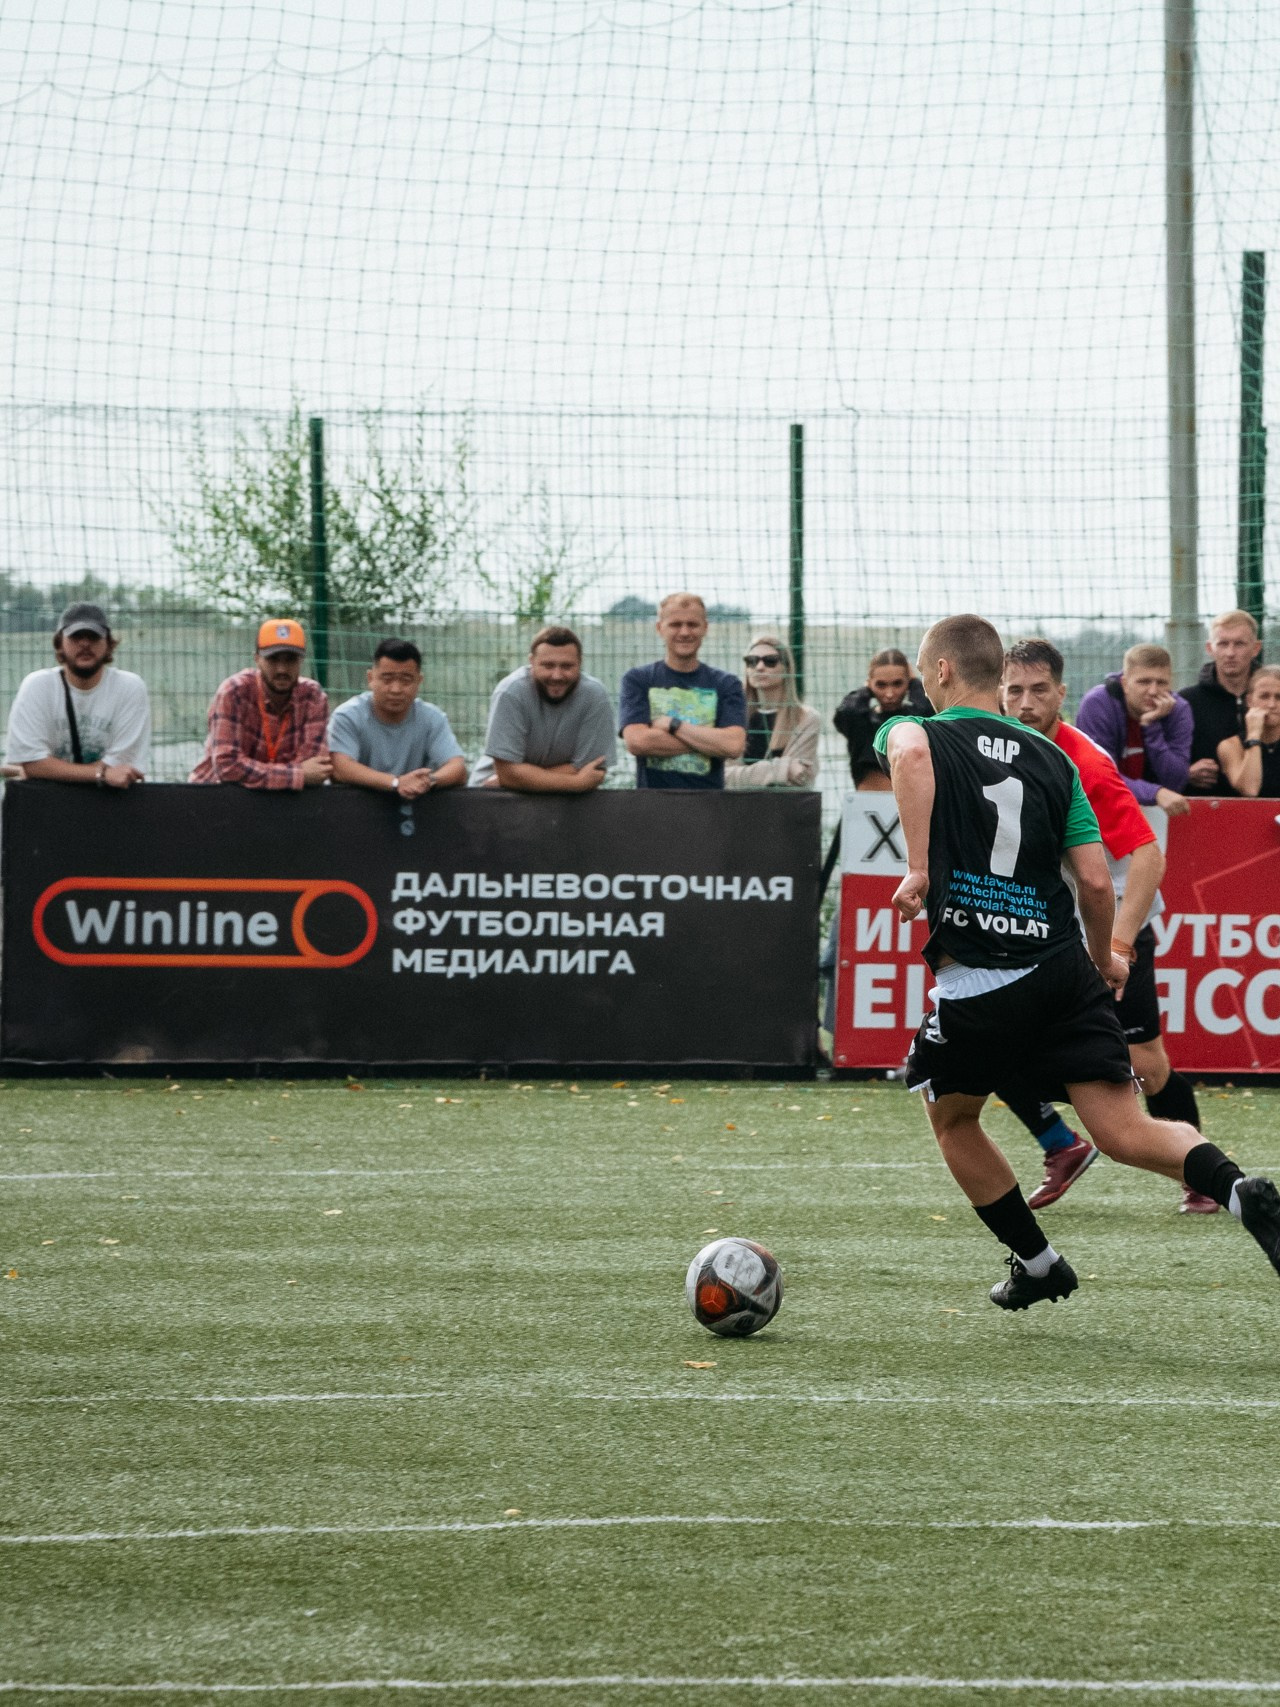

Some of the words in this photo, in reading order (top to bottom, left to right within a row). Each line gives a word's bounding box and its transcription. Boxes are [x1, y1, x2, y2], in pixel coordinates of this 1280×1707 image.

[977, 735, 1021, 764] GAP
[982, 776, 1024, 878] 1
[391, 872, 793, 902] ДАЛЬНЕВОСТОЧНАЯ
[65, 900, 279, 946] Winline
[393, 907, 665, 937] ФУТБОЛЬНАЯ
[941, 907, 969, 927] FC
[975, 912, 1050, 939] VOLAT
[392, 948, 636, 979] МЕДИАЛИГА
